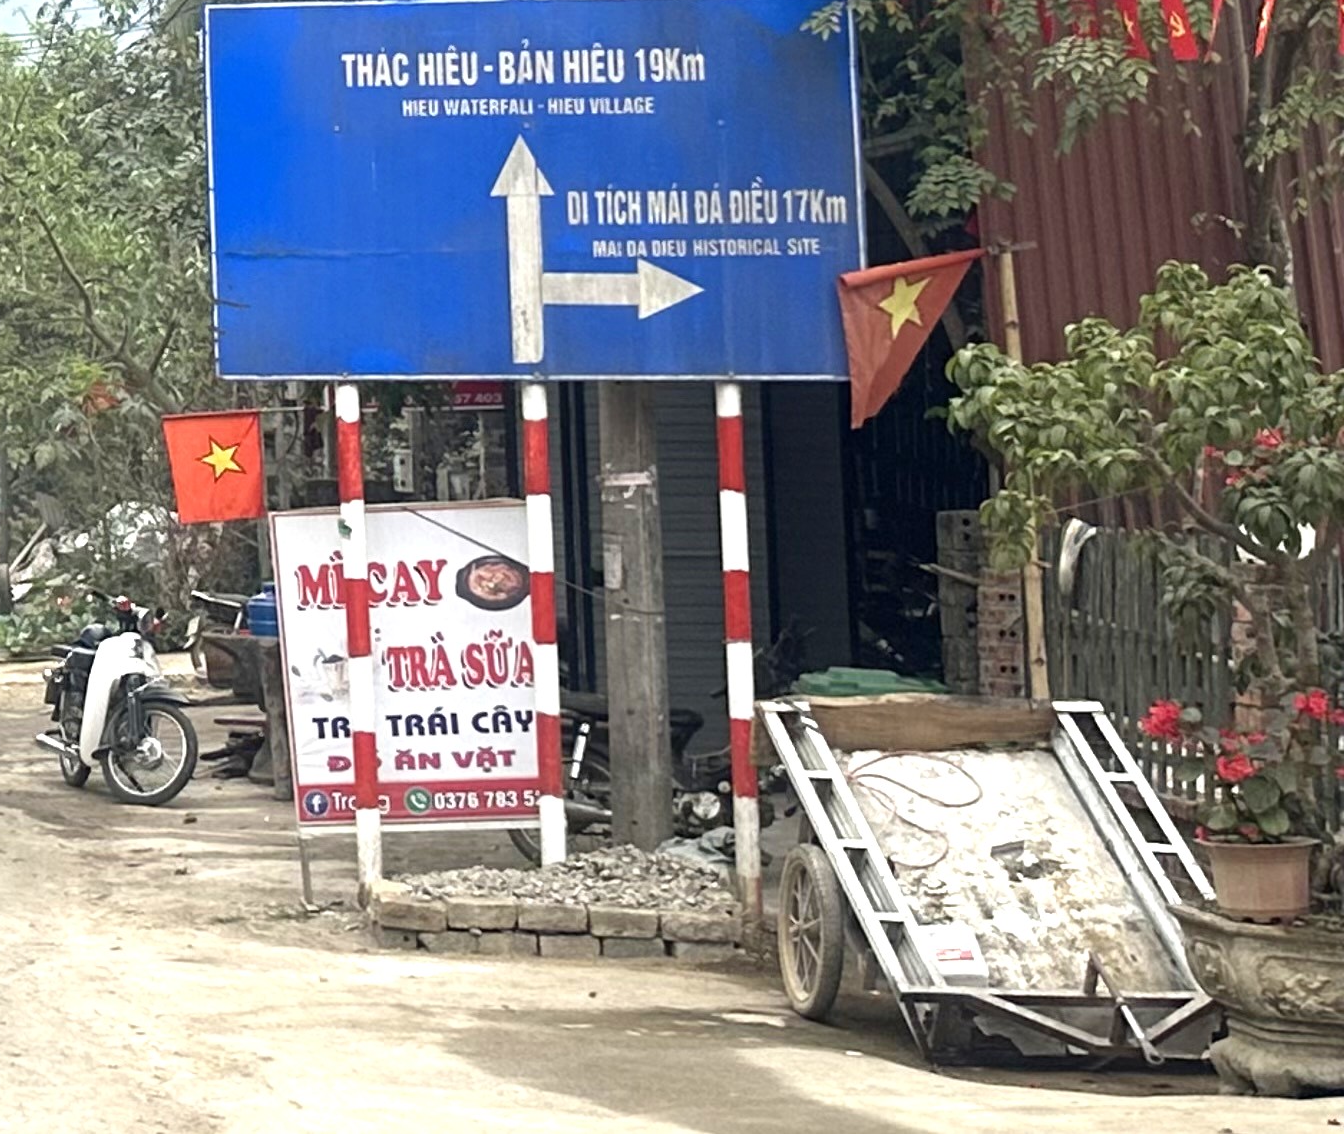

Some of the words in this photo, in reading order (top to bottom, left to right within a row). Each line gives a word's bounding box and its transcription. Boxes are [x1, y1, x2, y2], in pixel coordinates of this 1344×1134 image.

[340, 46, 410, 88] THÁC
[417, 44, 479, 87] HIÊU
[498, 37, 556, 86] BẢN
[562, 41, 626, 84] HIÊU
[633, 47, 706, 83] 19Km
[401, 98, 439, 117] HIEU
[547, 96, 586, 115] HIEU
[589, 95, 655, 115] VILLAGE
[566, 189, 590, 226] DI
[593, 182, 643, 226] TÍCH
[646, 181, 689, 225] MÁI
[693, 181, 724, 225] ĐÁ
[728, 174, 779, 225] ĐIỀU
[781, 187, 848, 225] 17Km
[592, 239, 623, 258] MAI
[625, 238, 648, 258] DA
[651, 238, 688, 258] DIEU
[692, 236, 783, 257] HISTORICAL
[786, 236, 822, 256] SITE
[367, 559, 448, 608] CAY
[382, 631, 458, 692] TRÀ
[462, 629, 535, 688] SỮA
[385, 707, 459, 736] TRÁI
[471, 705, 533, 734] CÂY
[394, 749, 441, 771] ĂN
[451, 746, 516, 773] VẶT
[434, 791, 480, 809] 0376
[483, 790, 519, 808] 783
